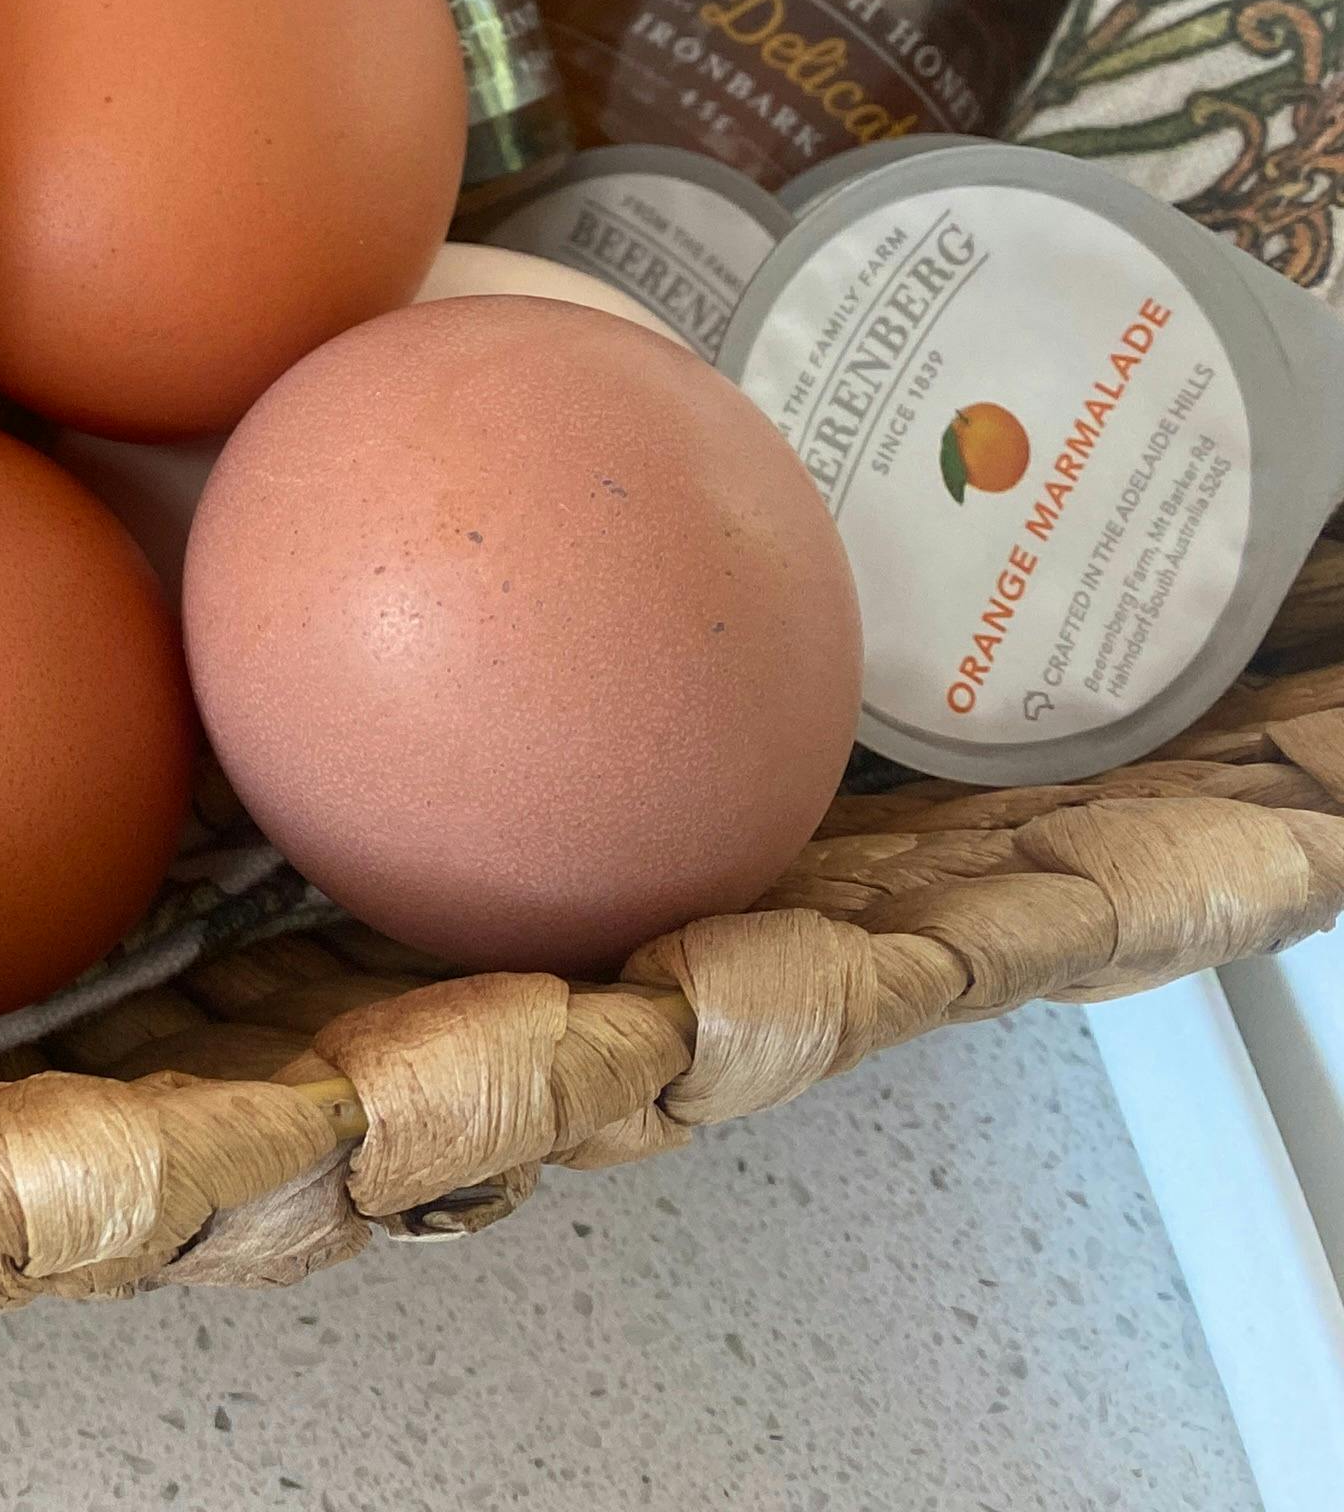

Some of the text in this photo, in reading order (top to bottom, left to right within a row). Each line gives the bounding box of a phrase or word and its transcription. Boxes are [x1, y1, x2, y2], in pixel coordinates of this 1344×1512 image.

[783, 227, 909, 417] THE FAMILY FARM
[805, 222, 977, 503] ERENBERG
[871, 349, 944, 476] SINCE 1839
[947, 297, 1174, 715] ORANGE MARMALADE
[1043, 362, 1215, 688] CRAFTED IN THE ADELAIDE HILLS
[1084, 590, 1140, 694] Beerenberg
[1146, 513, 1168, 544] Mt
[1159, 457, 1203, 517] Barker
[1191, 434, 1217, 461] Rd
[1105, 614, 1154, 699] Hahndorf
[1140, 567, 1179, 619] South
[1164, 494, 1210, 569] Australia
